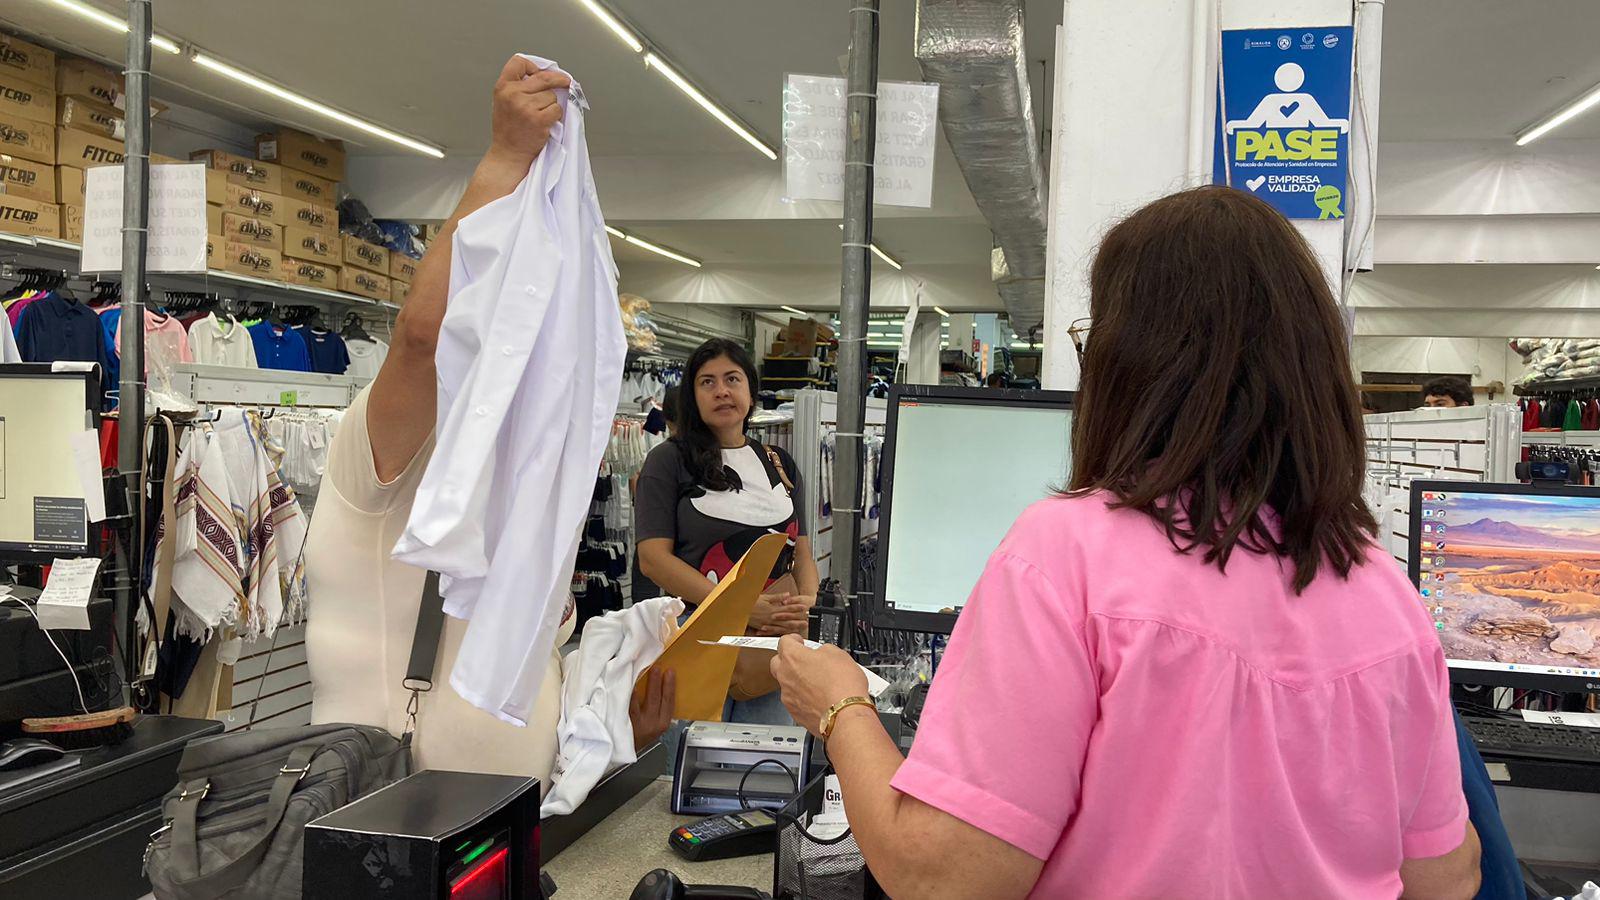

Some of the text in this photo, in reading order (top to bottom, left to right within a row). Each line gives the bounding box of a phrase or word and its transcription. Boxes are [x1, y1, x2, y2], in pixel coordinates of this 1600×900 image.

[1235, 130, 1339, 160] PASE
[0, 164, 36, 184] TCAP
[1268, 175, 1320, 183] EMPRESA
[1268, 184, 1321, 192] VALIDADA
[0, 206, 39, 221] TCAP
